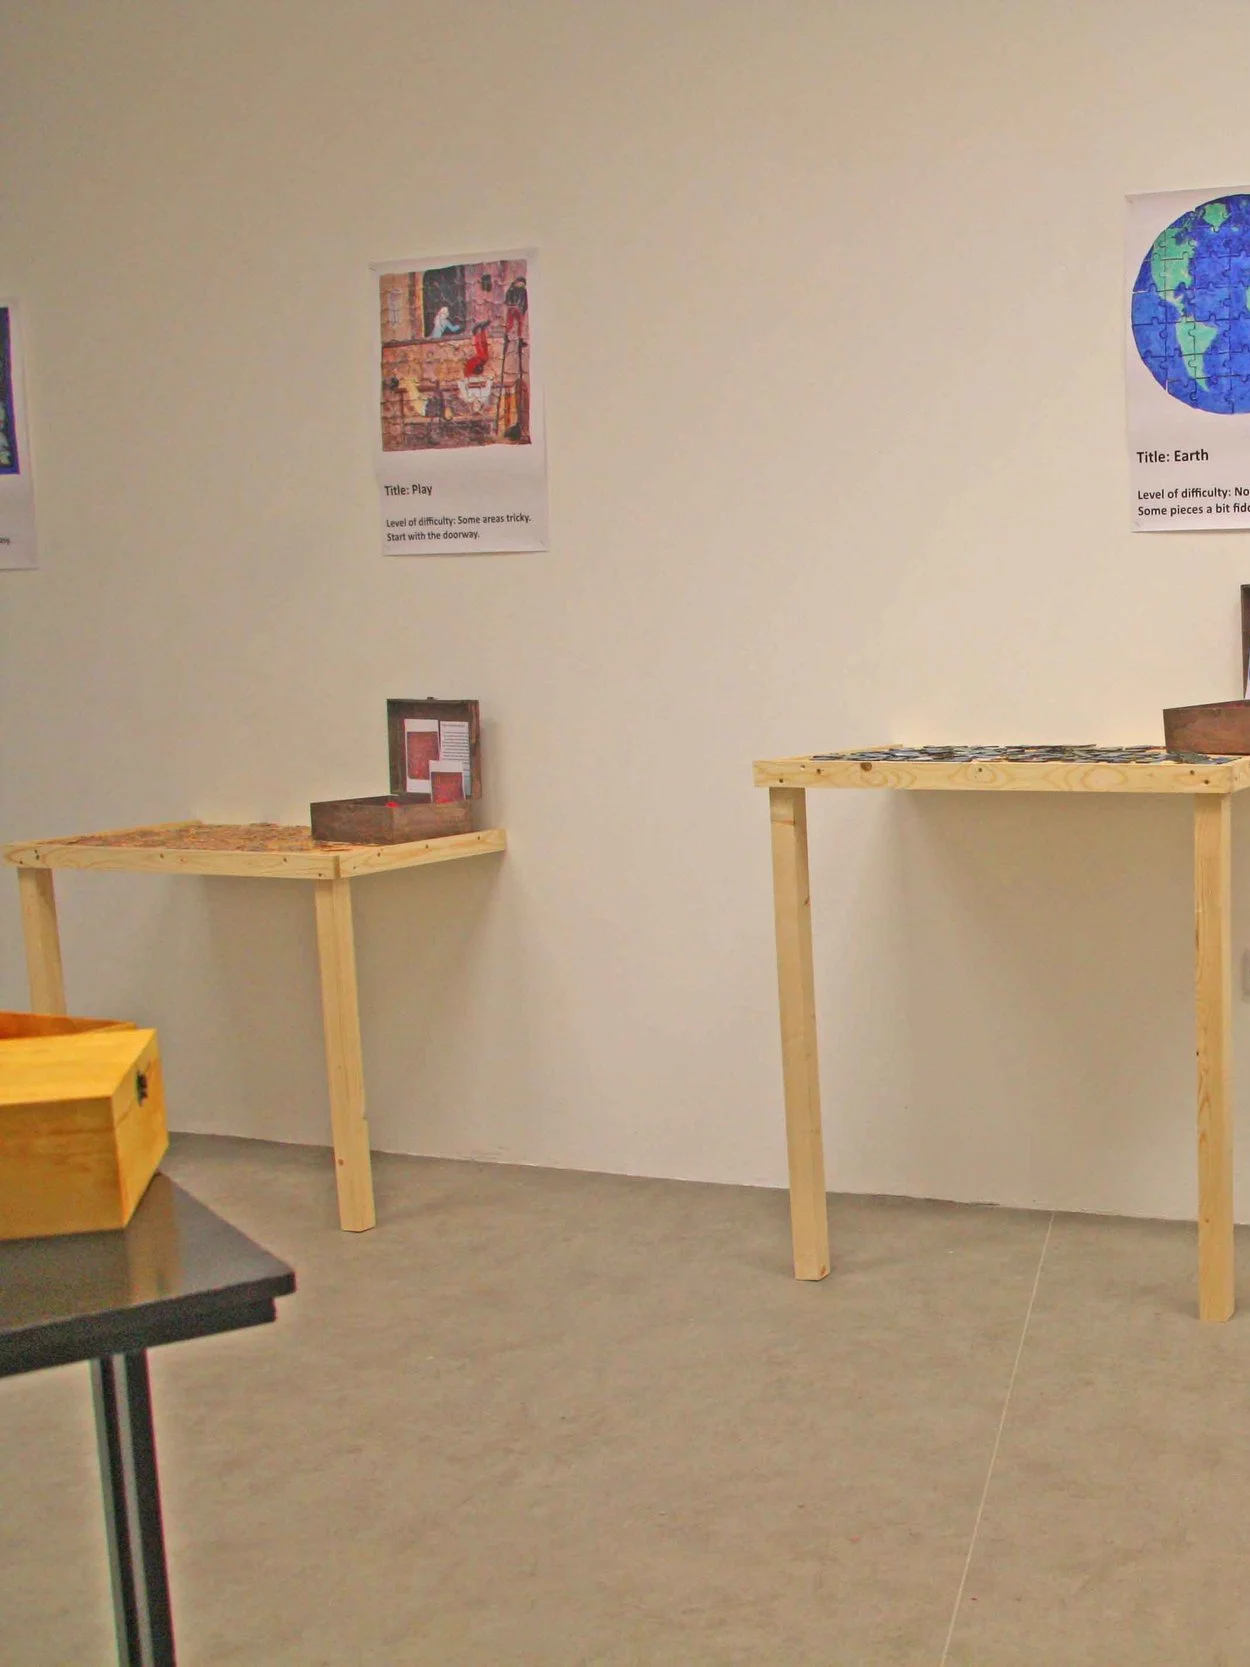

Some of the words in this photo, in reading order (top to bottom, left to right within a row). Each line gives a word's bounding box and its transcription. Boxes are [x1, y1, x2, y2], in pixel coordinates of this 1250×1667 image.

[1137, 451, 1170, 463] Title:
[1174, 449, 1209, 462] Earth
[385, 485, 410, 496] Title:
[412, 484, 432, 496] Play
[1138, 489, 1164, 500] Level
[1168, 489, 1179, 498] of
[1182, 488, 1231, 499] difficulty:
[1138, 506, 1167, 516] Some
[1170, 505, 1203, 517] pieces
[1206, 506, 1212, 514] a
[1216, 504, 1230, 514] bit
[386, 519, 407, 528] Level
[409, 518, 416, 526] of
[419, 516, 456, 527] difficulty:
[458, 516, 480, 524] Some
[482, 515, 504, 523] areas
[506, 513, 531, 523] tricky.
[387, 533, 406, 541] Start
[408, 532, 425, 540] with
[428, 532, 440, 540] the
[443, 531, 480, 540] doorway.
